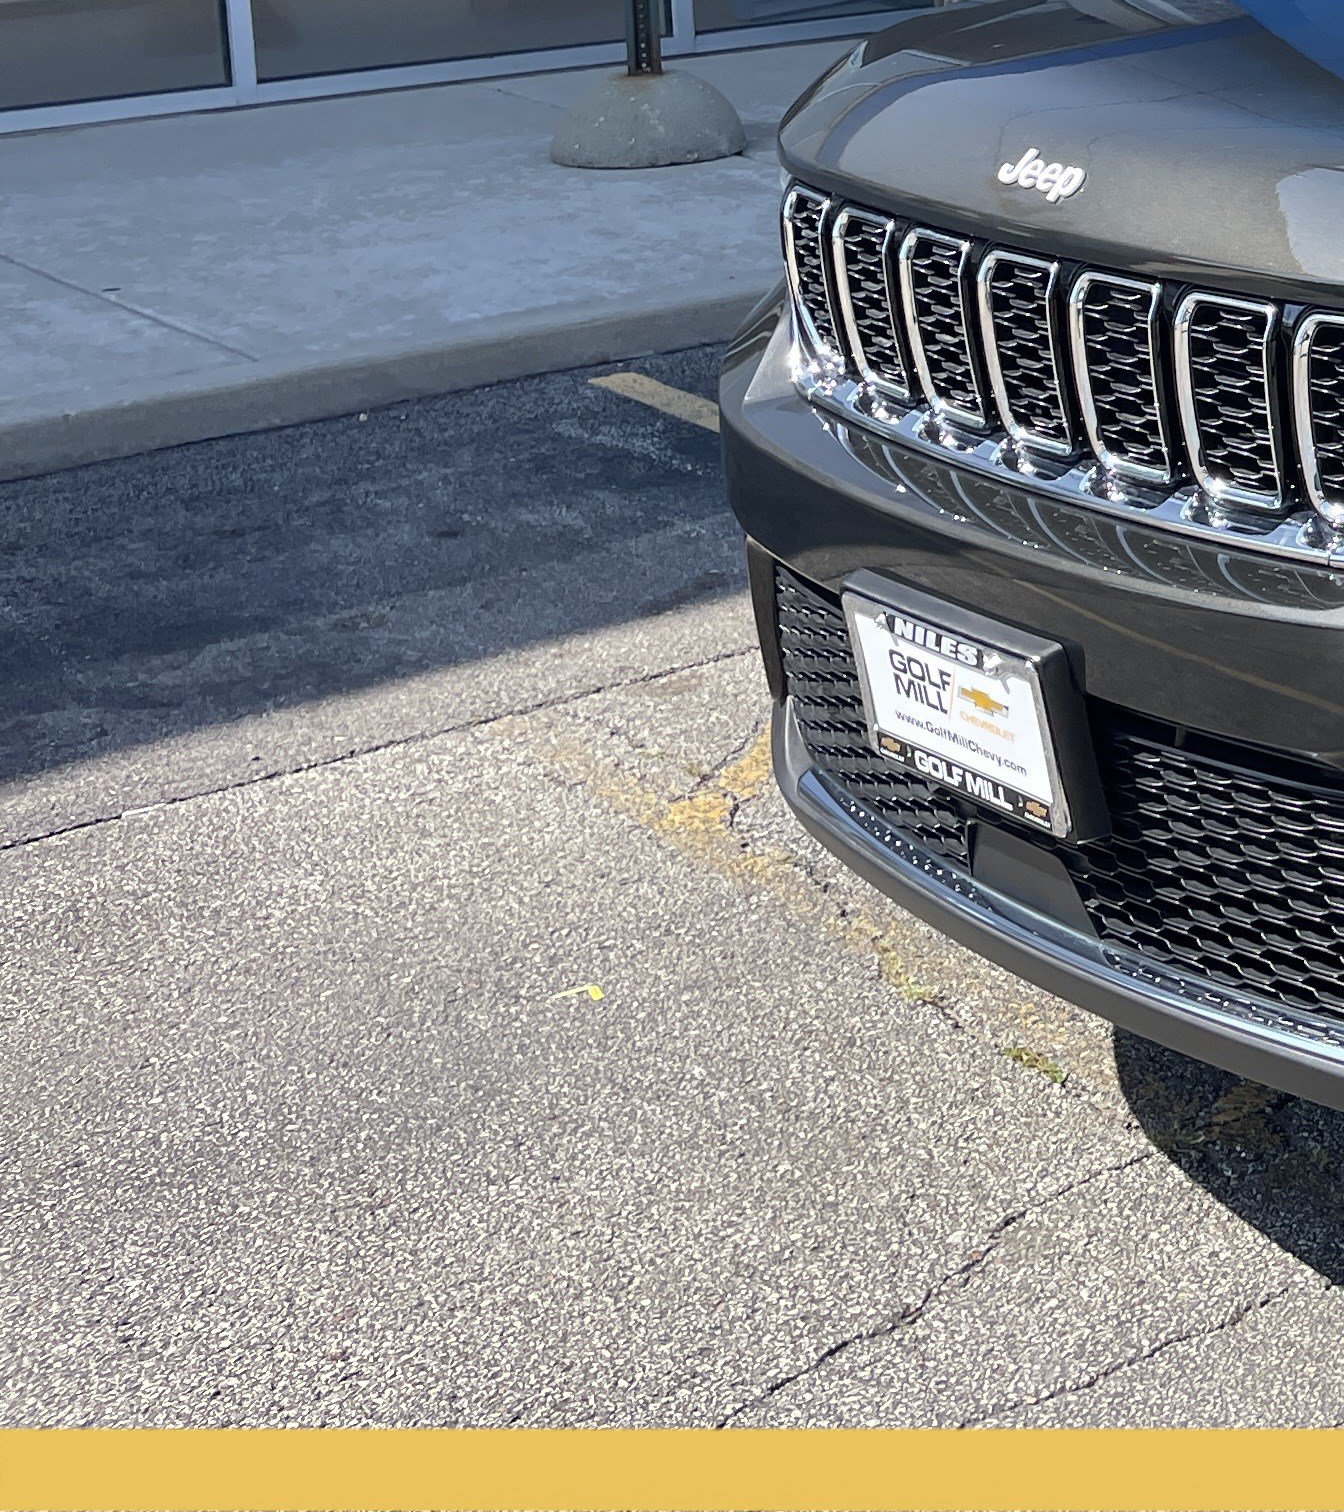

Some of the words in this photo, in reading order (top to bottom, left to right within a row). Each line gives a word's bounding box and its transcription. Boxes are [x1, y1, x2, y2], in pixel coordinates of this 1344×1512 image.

[998, 147, 1086, 203] Jeep
[893, 614, 979, 668] NILES
[889, 649, 951, 691] GOLF
[893, 671, 948, 715] MILL
[914, 749, 964, 788] GOLF
[964, 771, 1014, 812] MILL
